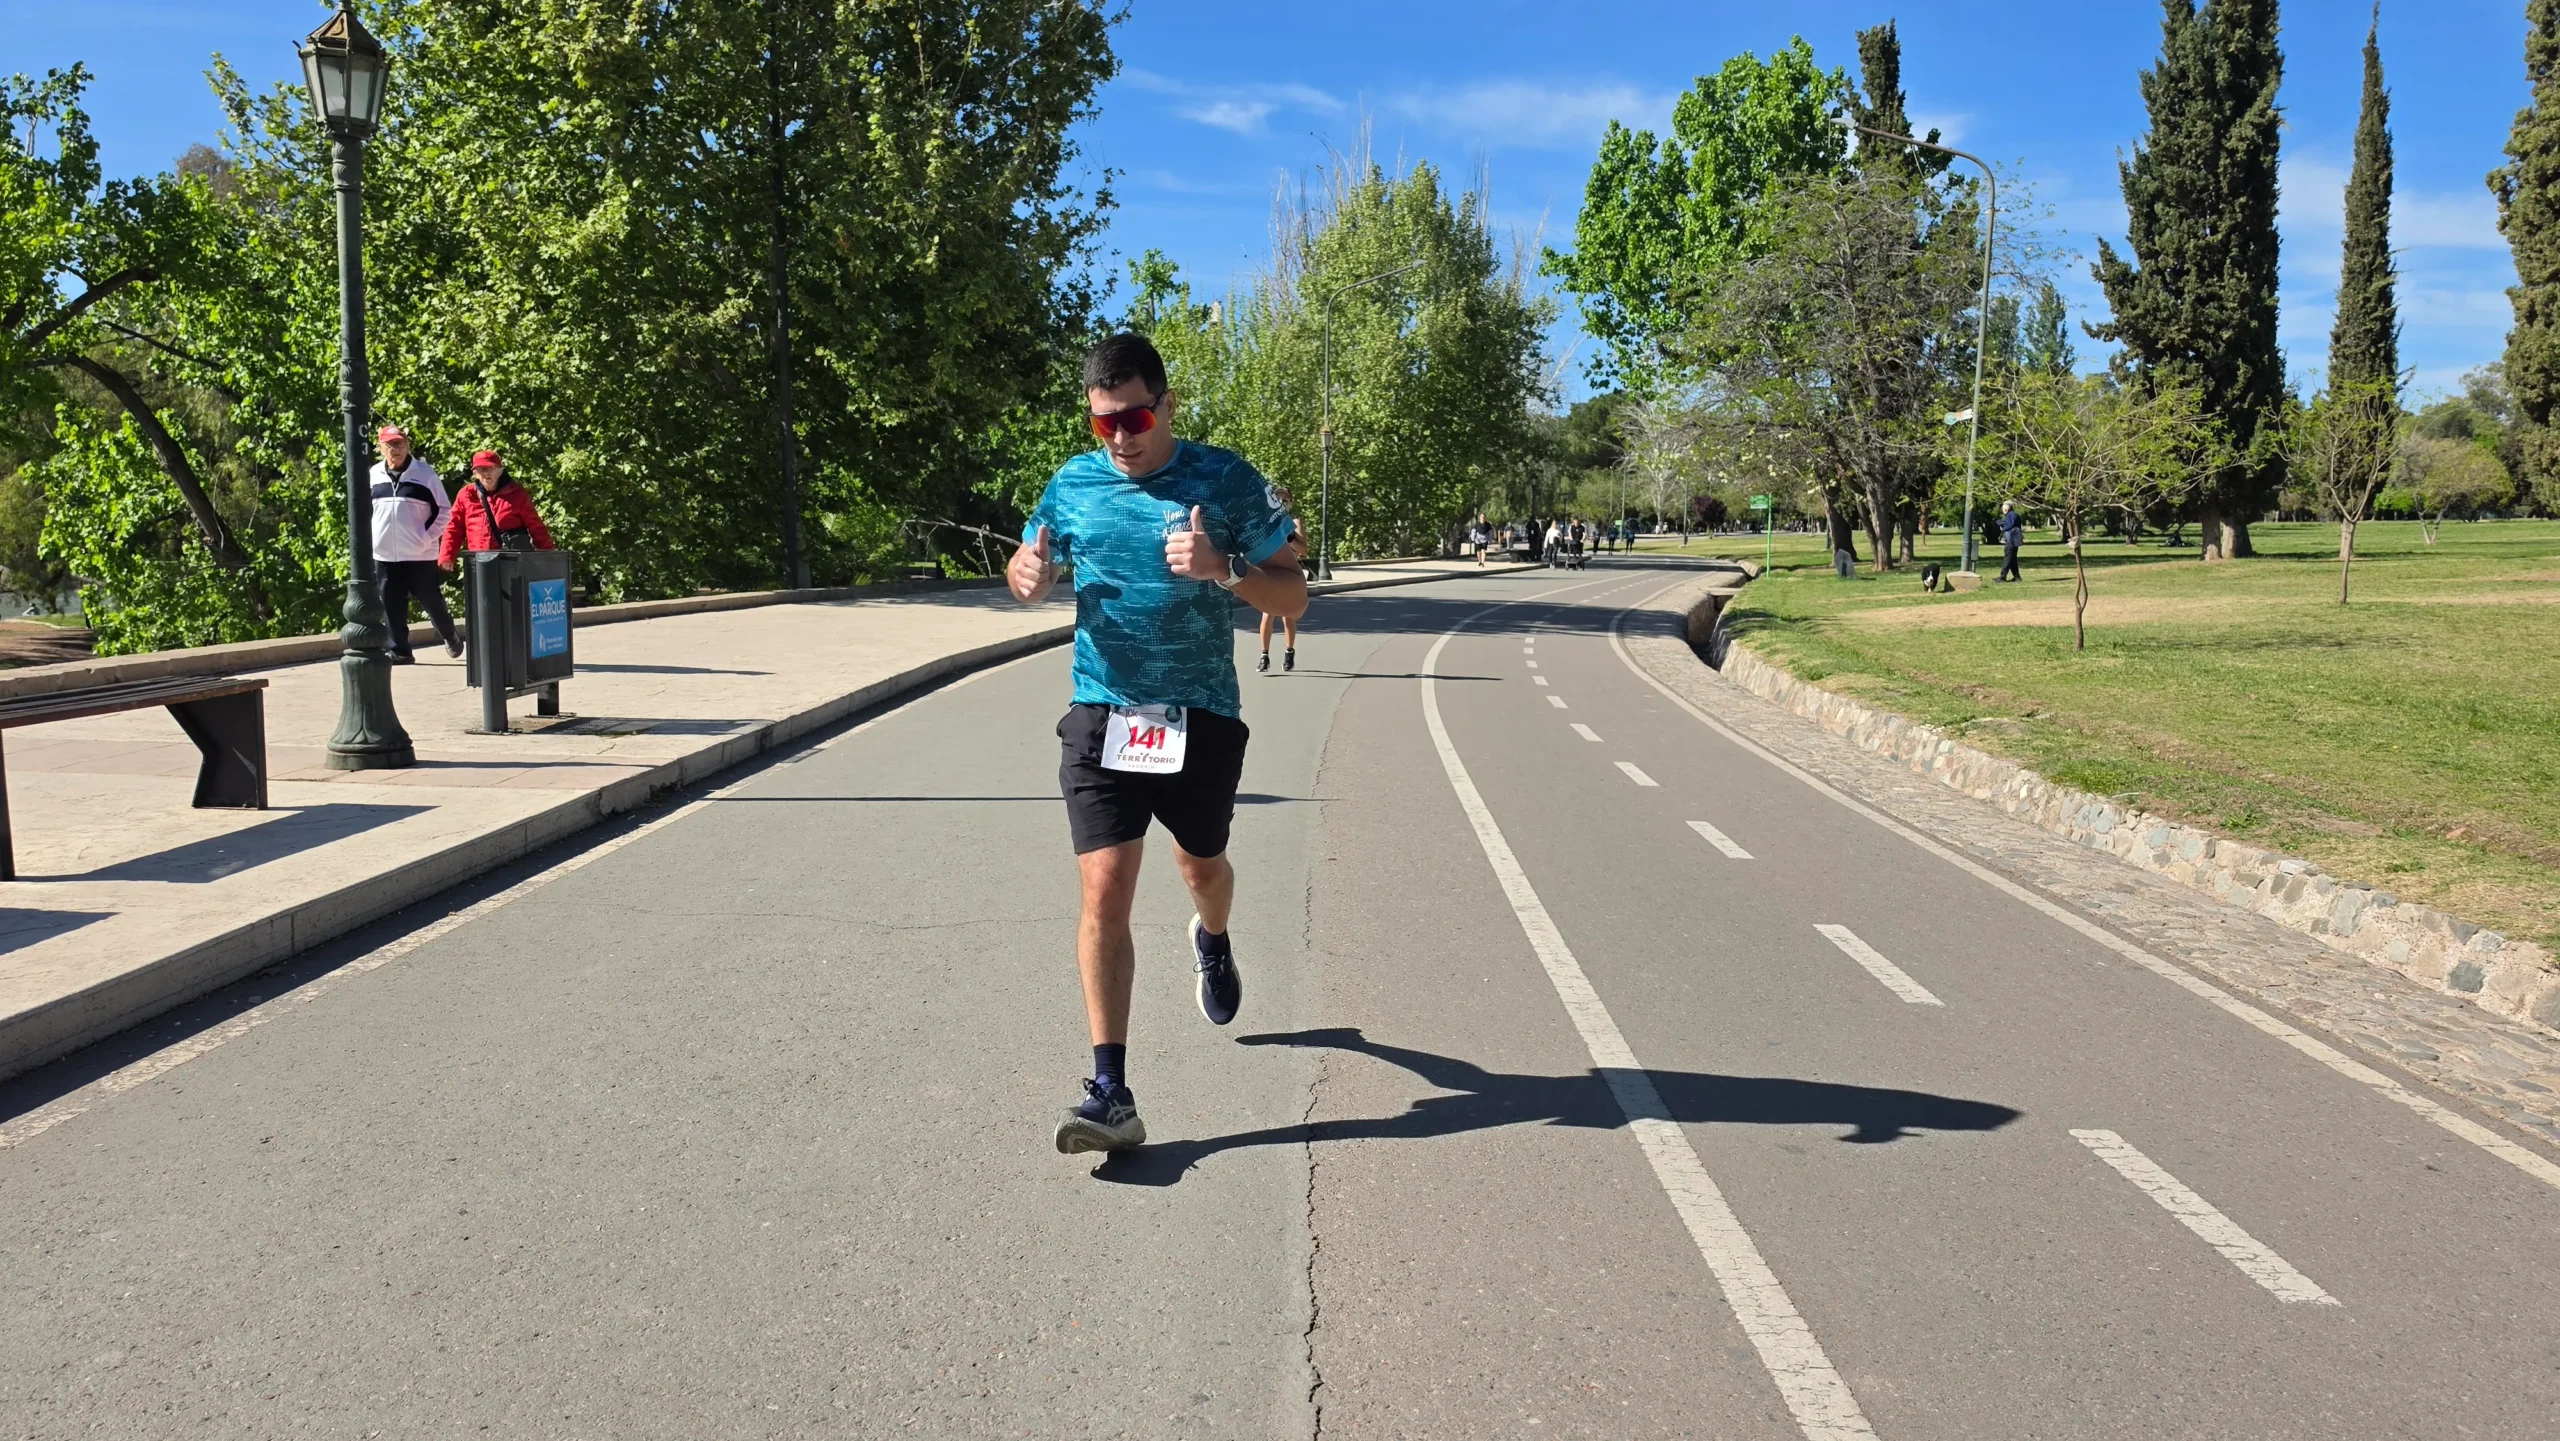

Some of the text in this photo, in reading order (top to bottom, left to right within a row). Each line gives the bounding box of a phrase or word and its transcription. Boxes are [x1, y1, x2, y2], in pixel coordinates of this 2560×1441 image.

[531, 599, 566, 617] EL PARQUE
[1128, 725, 1166, 749] 141
